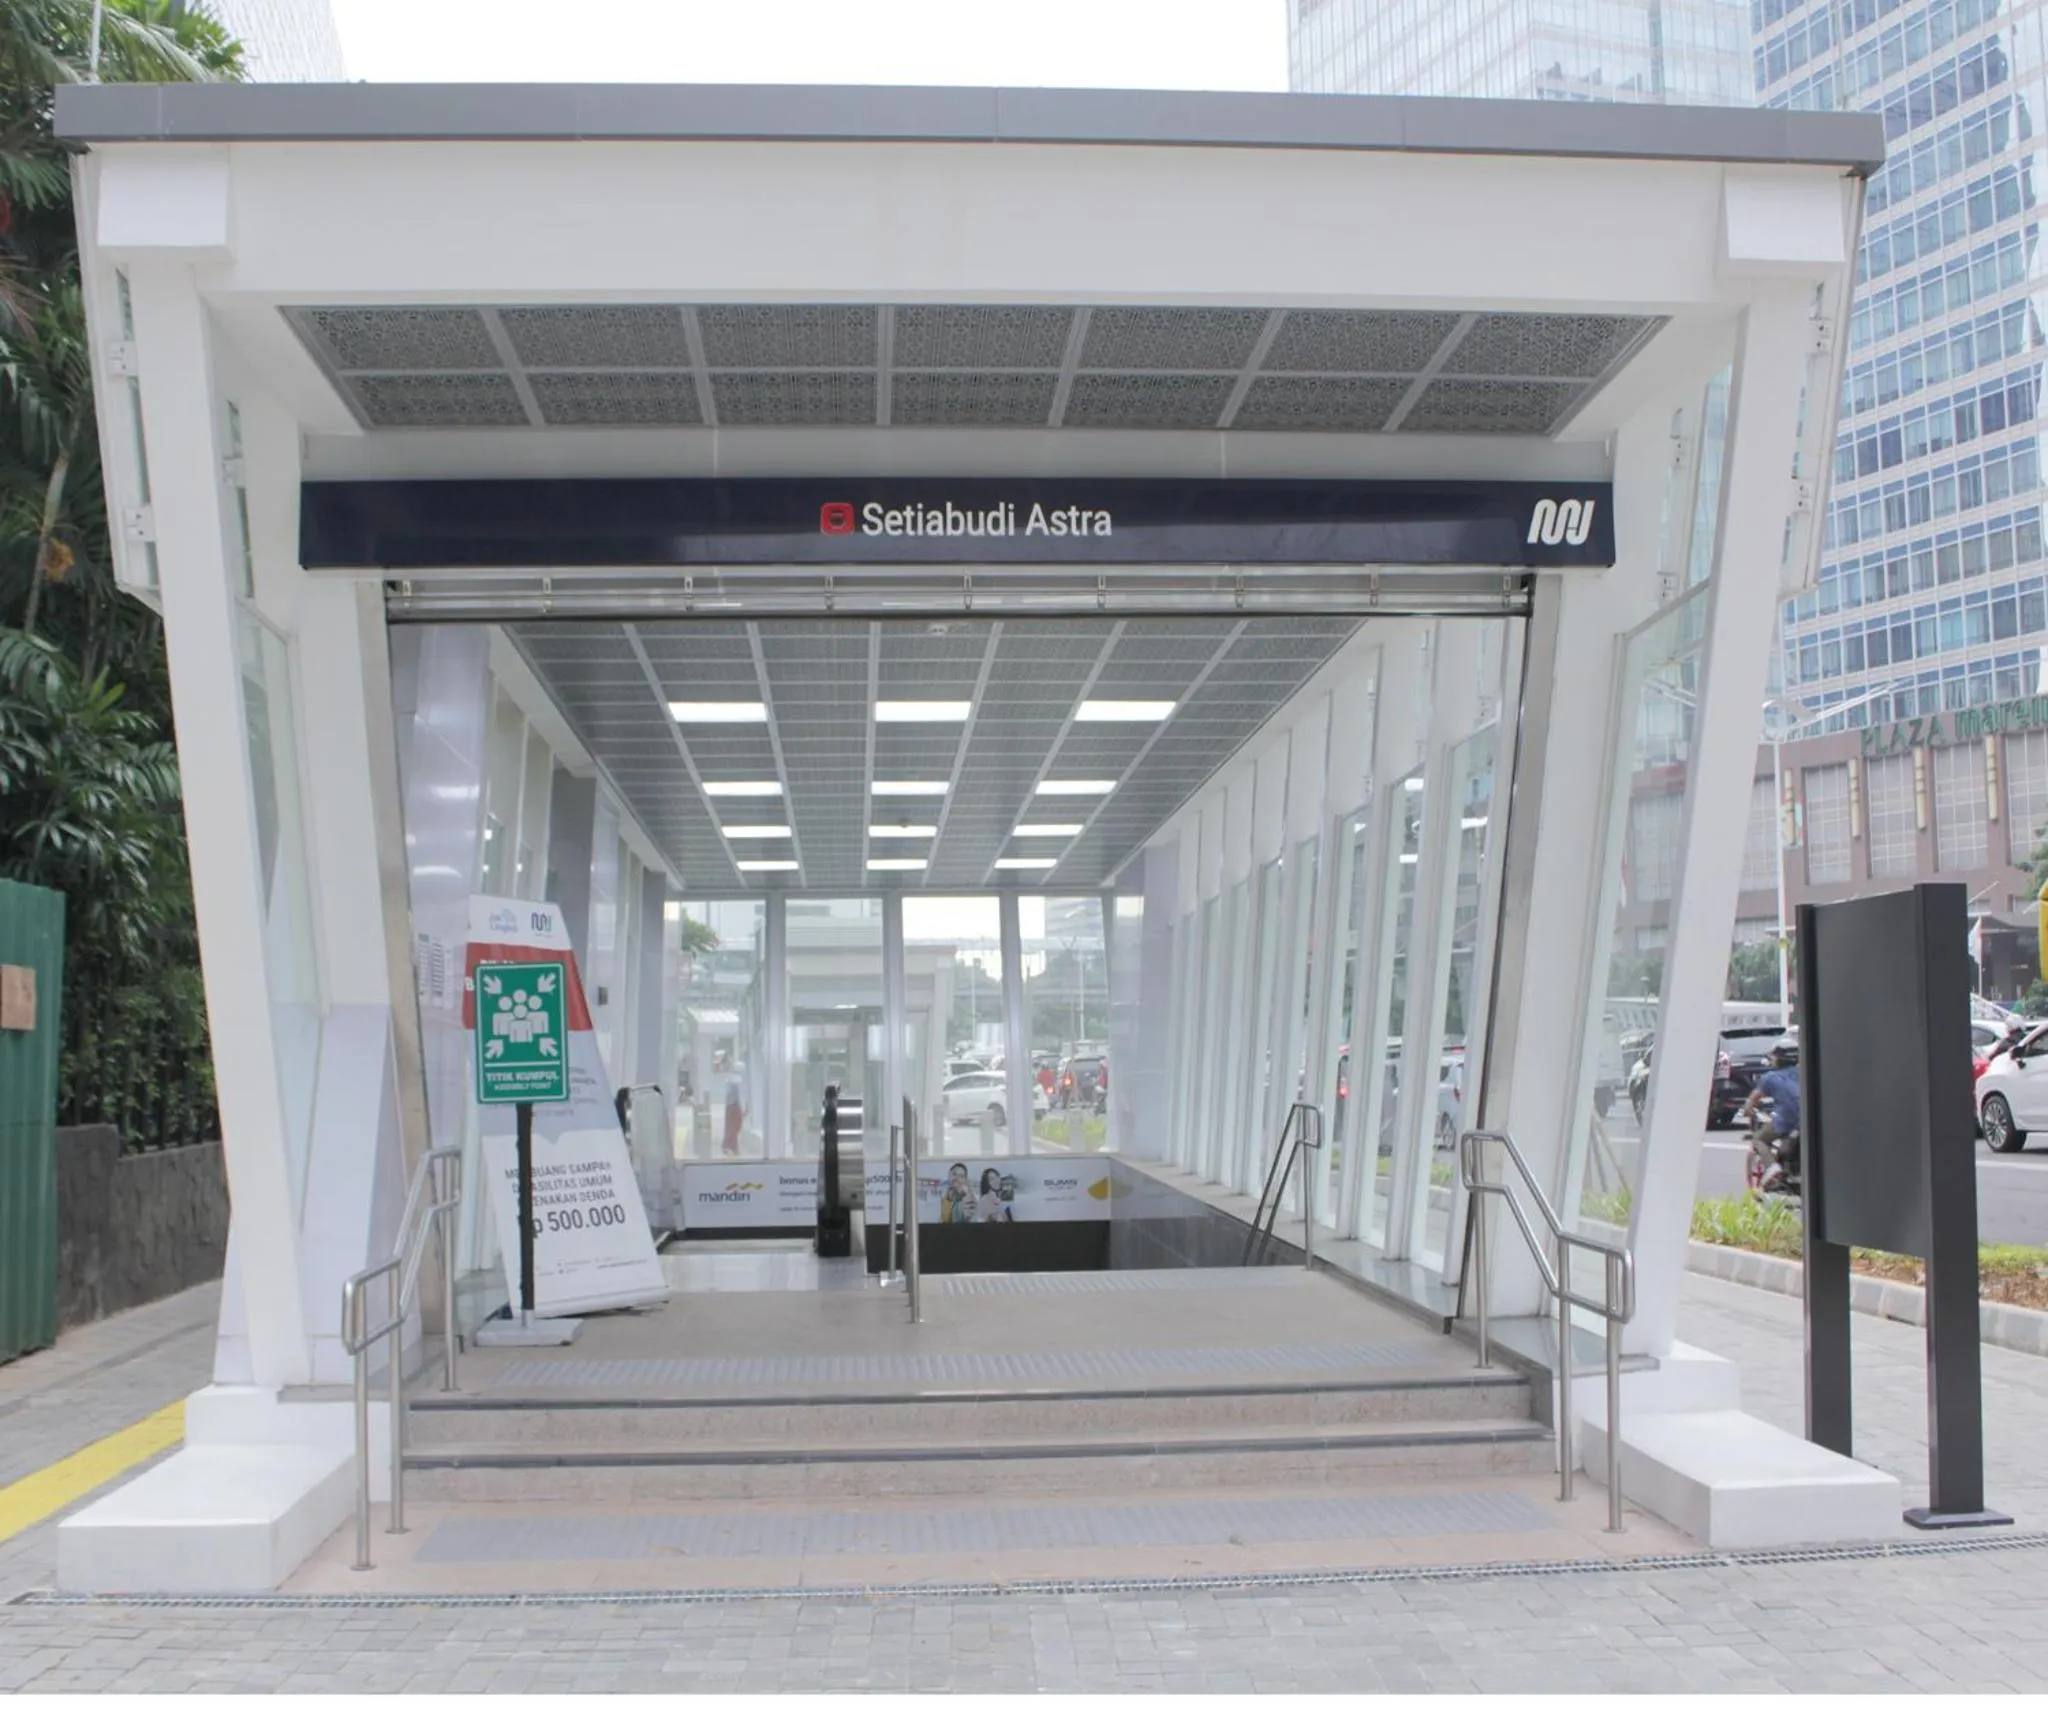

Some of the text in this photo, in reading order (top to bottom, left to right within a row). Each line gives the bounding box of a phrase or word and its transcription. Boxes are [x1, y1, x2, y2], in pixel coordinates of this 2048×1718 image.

[861, 502, 1113, 537] Setiabudi Astra
[1861, 714, 1946, 756] PLAZA
[578, 1189, 616, 1203] DENDA
[698, 1190, 751, 1203] mandiri
[546, 1203, 626, 1233] 500.000
